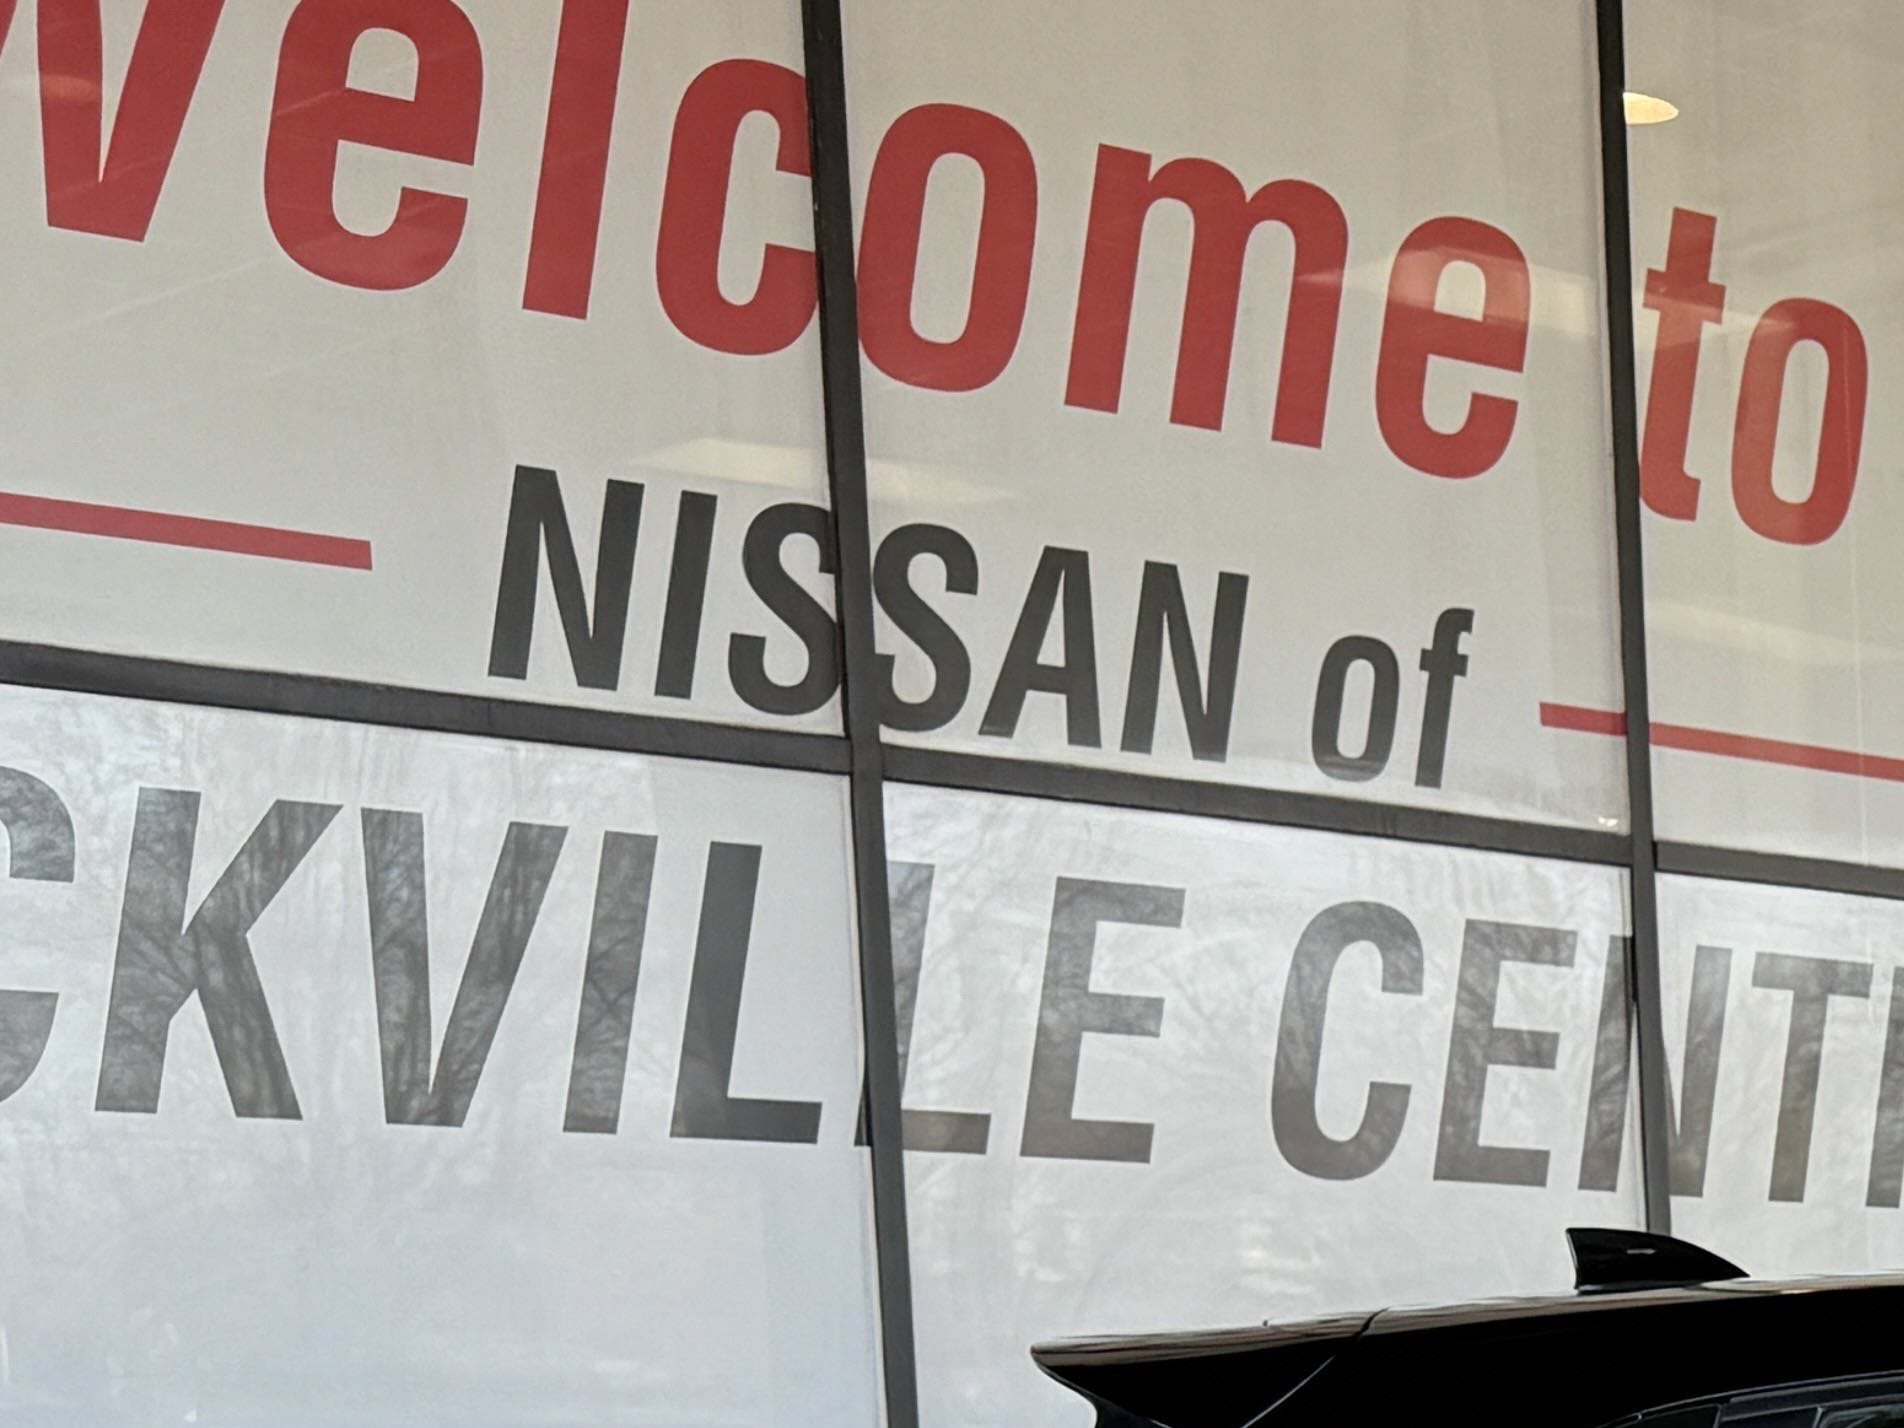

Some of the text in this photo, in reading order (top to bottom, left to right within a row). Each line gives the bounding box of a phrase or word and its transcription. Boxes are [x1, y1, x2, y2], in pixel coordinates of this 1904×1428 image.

[1637, 206, 1868, 546] to
[488, 463, 1474, 789] NISSAN of
